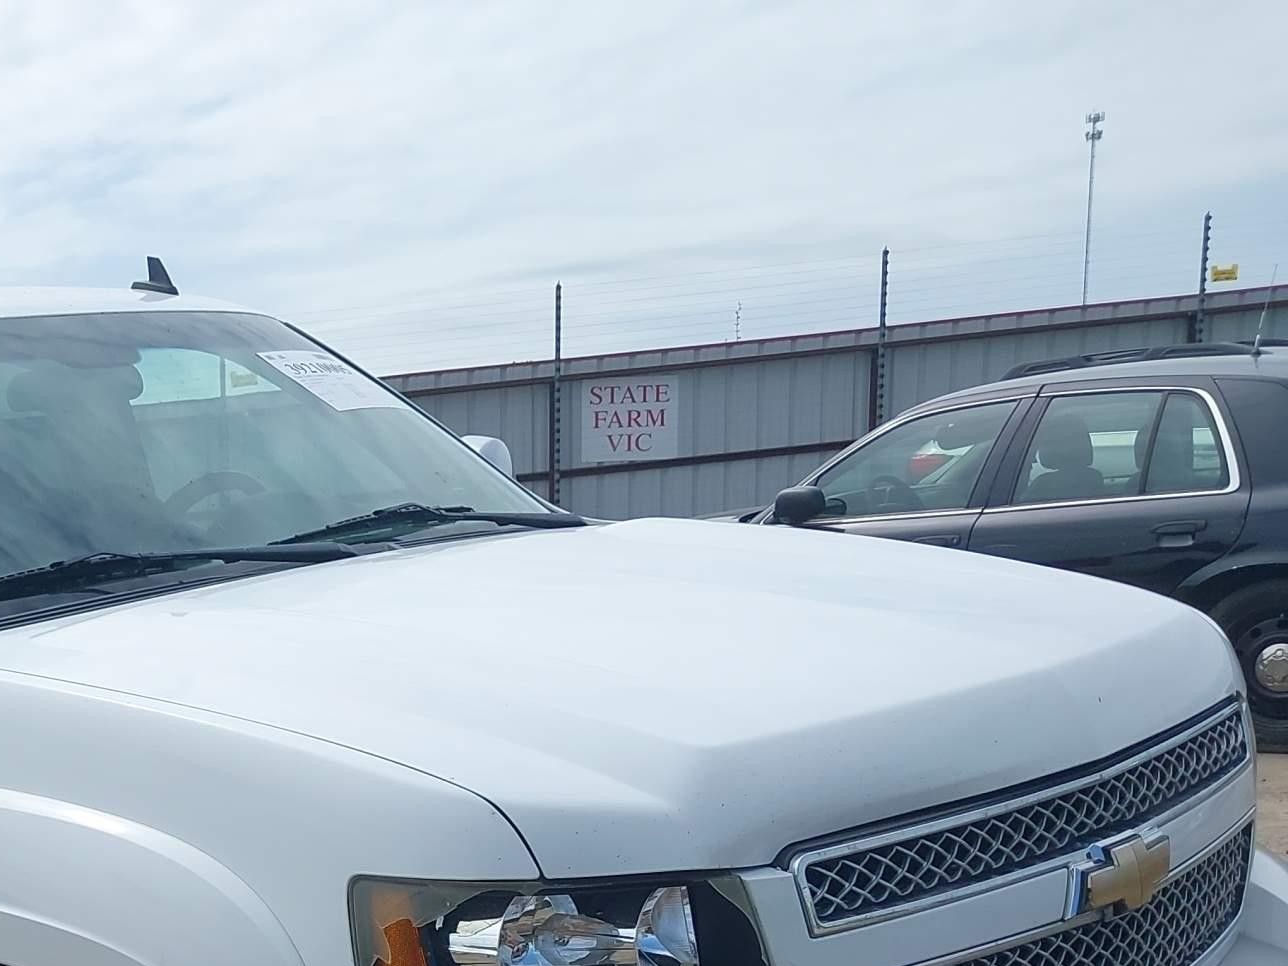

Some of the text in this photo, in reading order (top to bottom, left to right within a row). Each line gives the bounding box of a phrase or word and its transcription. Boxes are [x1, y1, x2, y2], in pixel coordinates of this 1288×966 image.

[589, 384, 671, 406] STATE
[592, 408, 666, 429] FARM
[606, 433, 653, 453] VIC
